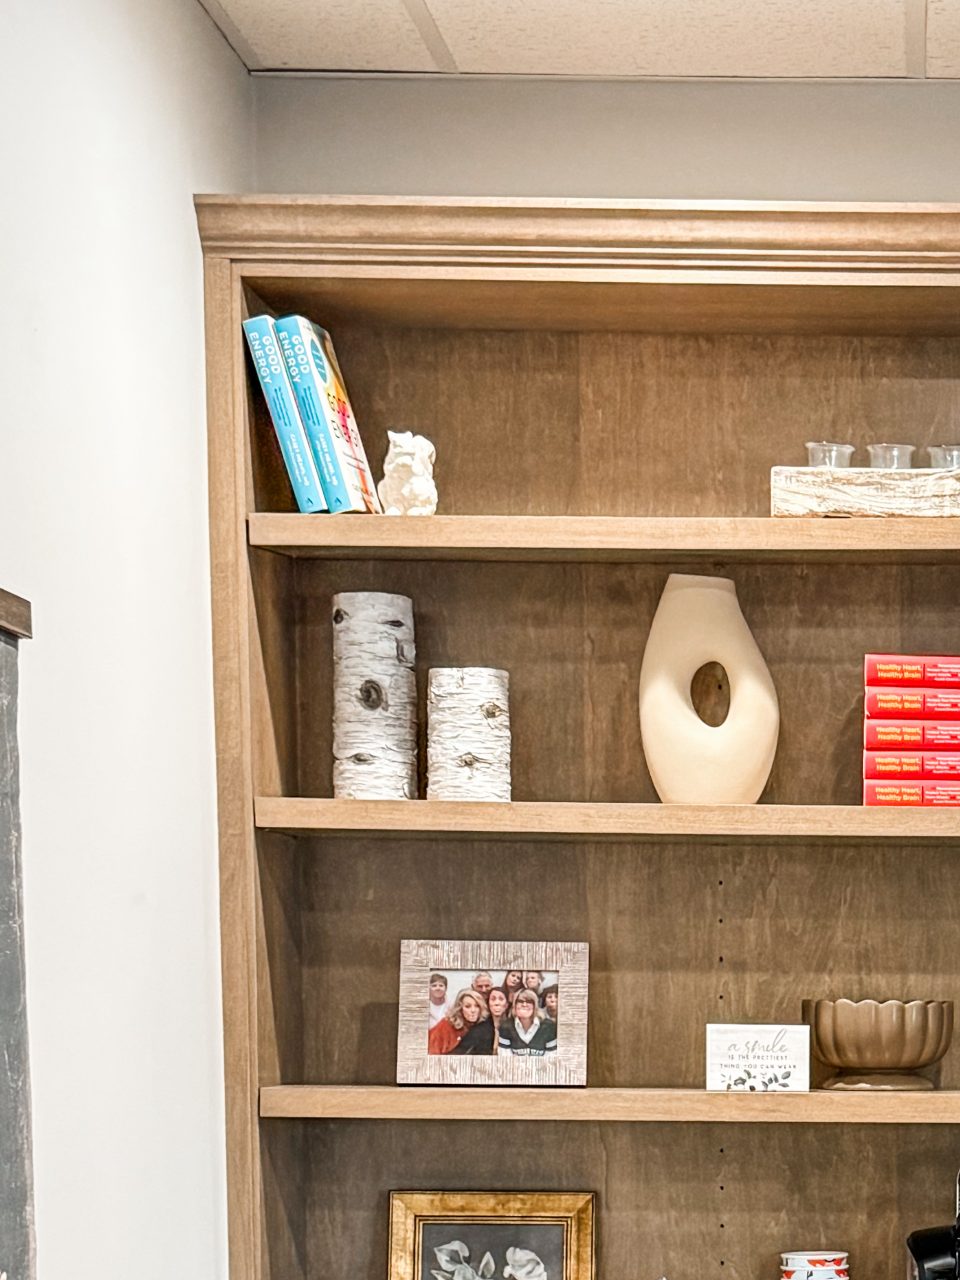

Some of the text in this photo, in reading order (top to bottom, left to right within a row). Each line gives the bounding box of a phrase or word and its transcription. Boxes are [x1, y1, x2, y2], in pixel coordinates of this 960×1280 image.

[249, 332, 272, 383] ENERGY
[262, 335, 281, 374] GOOD
[279, 331, 301, 382] ENERGY
[292, 335, 310, 374] GOOD
